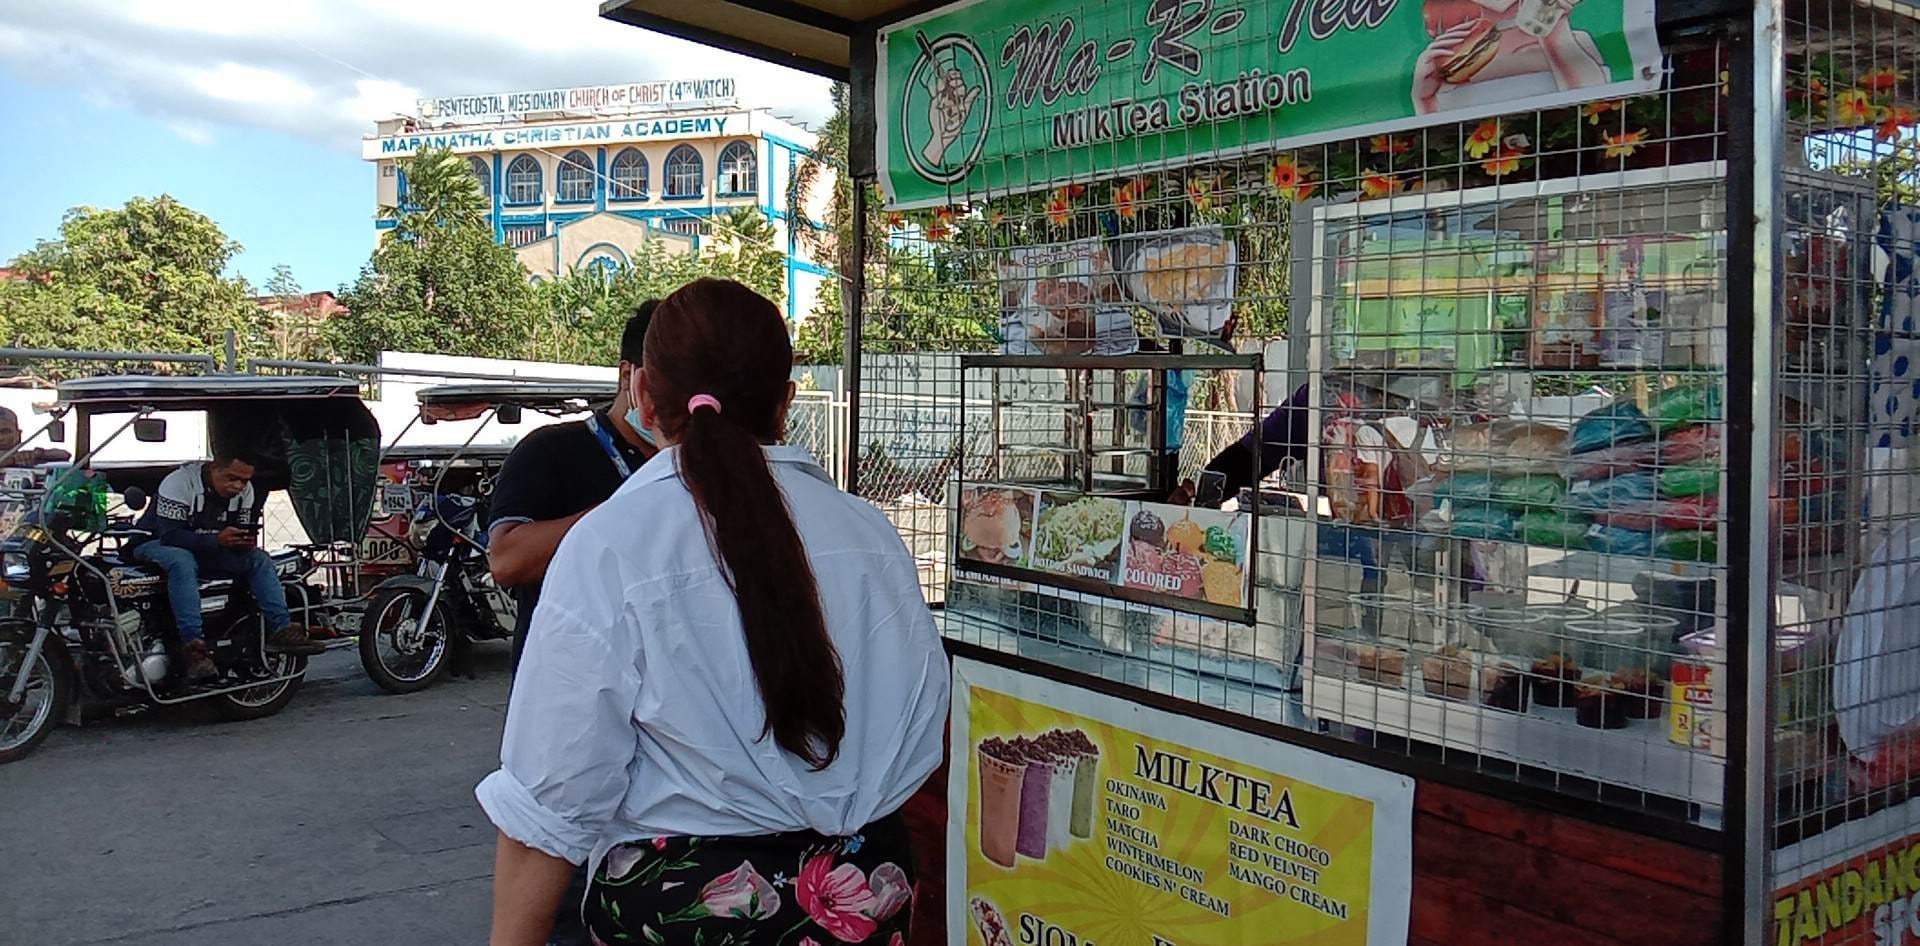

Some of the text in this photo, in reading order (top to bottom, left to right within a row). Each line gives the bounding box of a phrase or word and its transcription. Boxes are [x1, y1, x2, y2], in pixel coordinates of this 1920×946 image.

[439, 96, 505, 117] PENTECOSTAL
[508, 91, 566, 112] MISSIONARY
[569, 87, 609, 108] CHURCH
[612, 89, 626, 101] OF
[630, 83, 667, 103] CHRIST
[693, 78, 736, 98] WATCH)
[1053, 67, 1311, 148] MilkTea Station
[382, 117, 728, 153] MARANATHA CHRISTIAN ACADEMY
[1124, 567, 1182, 591] COLORED
[1106, 779, 1167, 810] OKINAWA
[1134, 745, 1300, 828] MILKTEA
[1106, 798, 1140, 821] TARO
[1106, 818, 1159, 849] MATCHA
[1229, 819, 1330, 867] DARK CHOCO
[1106, 836, 1203, 884] WINTERMELON
[1229, 841, 1320, 885] RED VELVET
[1105, 856, 1161, 889] COOKIES
[1180, 885, 1230, 917] CREAM
[1229, 862, 1348, 919] MANGO CREAM
